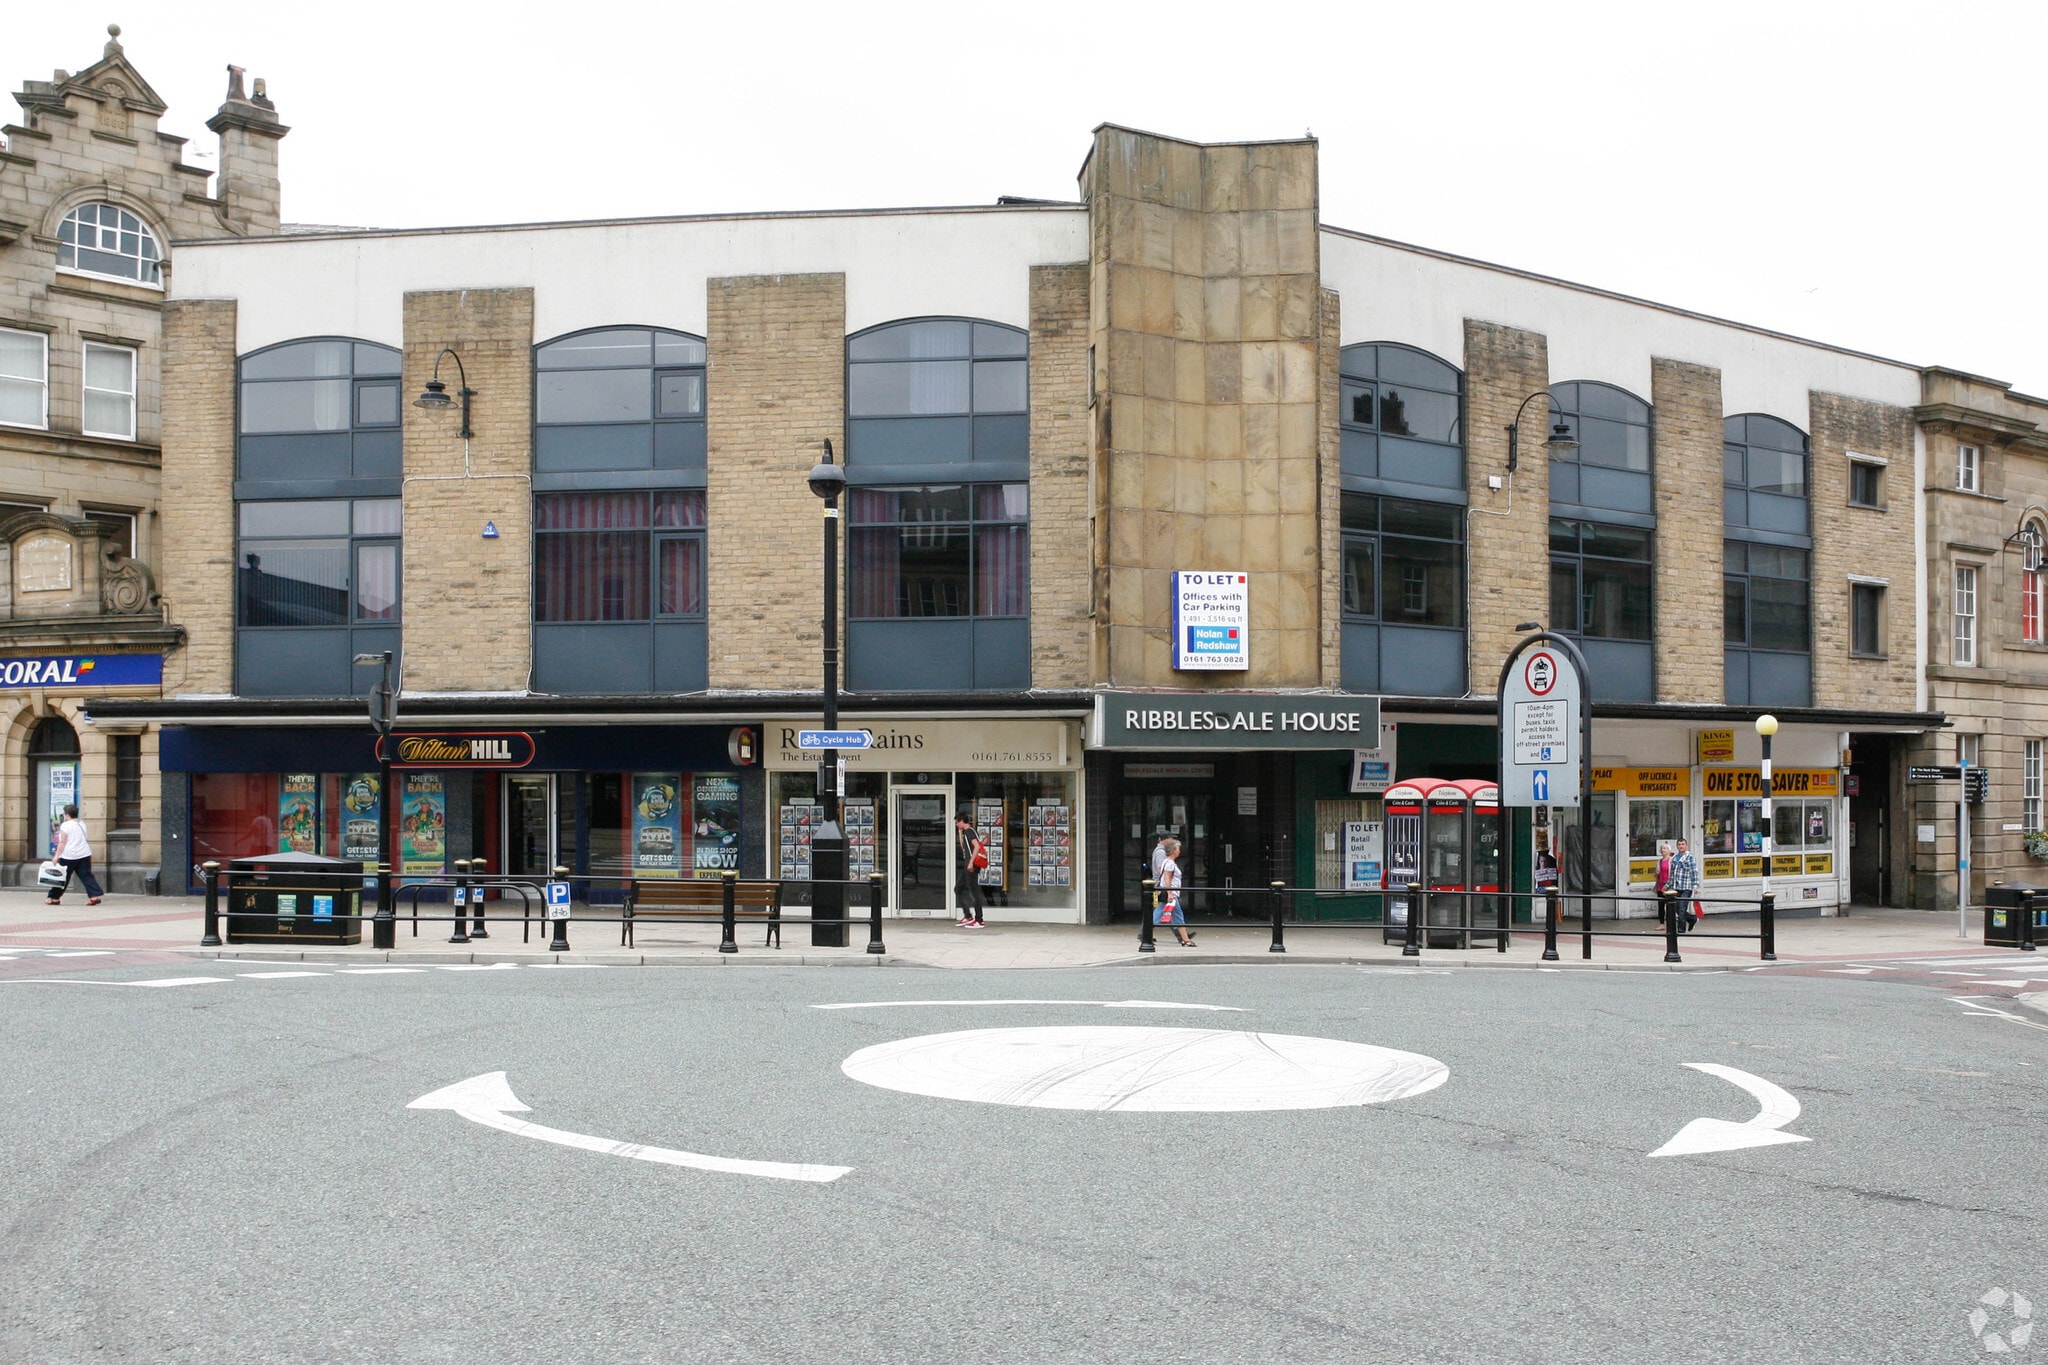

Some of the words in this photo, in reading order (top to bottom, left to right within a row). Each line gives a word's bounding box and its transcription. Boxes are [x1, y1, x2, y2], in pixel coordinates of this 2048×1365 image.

[1184, 575, 1203, 585] TO
[1208, 575, 1234, 585] LET
[1183, 593, 1218, 601] Offices
[1221, 593, 1242, 601] with
[1183, 603, 1200, 611] Car
[1203, 603, 1241, 613] Parking
[1196, 629, 1223, 638] Nolan
[1196, 641, 1238, 650] Redshaw
[1125, 710, 1274, 731] RIBBLESDALE
[1281, 712, 1360, 732] HOUSE
[822, 736, 844, 745] Cycle
[845, 736, 862, 744] Hub
[1703, 732, 1731, 740] KINGS
[399, 736, 471, 761] William
[471, 740, 512, 760] HILL
[781, 752, 799, 761] The
[972, 752, 1052, 761] 0161.761.8555
[1595, 770, 1613, 778] PLACE
[1638, 772, 1649, 780] OFF
[1650, 772, 1672, 781] LICENCE
[1673, 772, 1678, 780] &
[706, 778, 728, 786] NEXT
[1707, 772, 1734, 792] ONE
[1771, 773, 1810, 792] SAVER
[1639, 783, 1678, 792] NEWSAGENTS
[696, 793, 738, 801] GAMING
[1350, 824, 1361, 832] TO
[1364, 824, 1379, 832] LET
[696, 854, 738, 868] NOW
[456, 889, 464, 899] P
[552, 884, 567, 904] P
